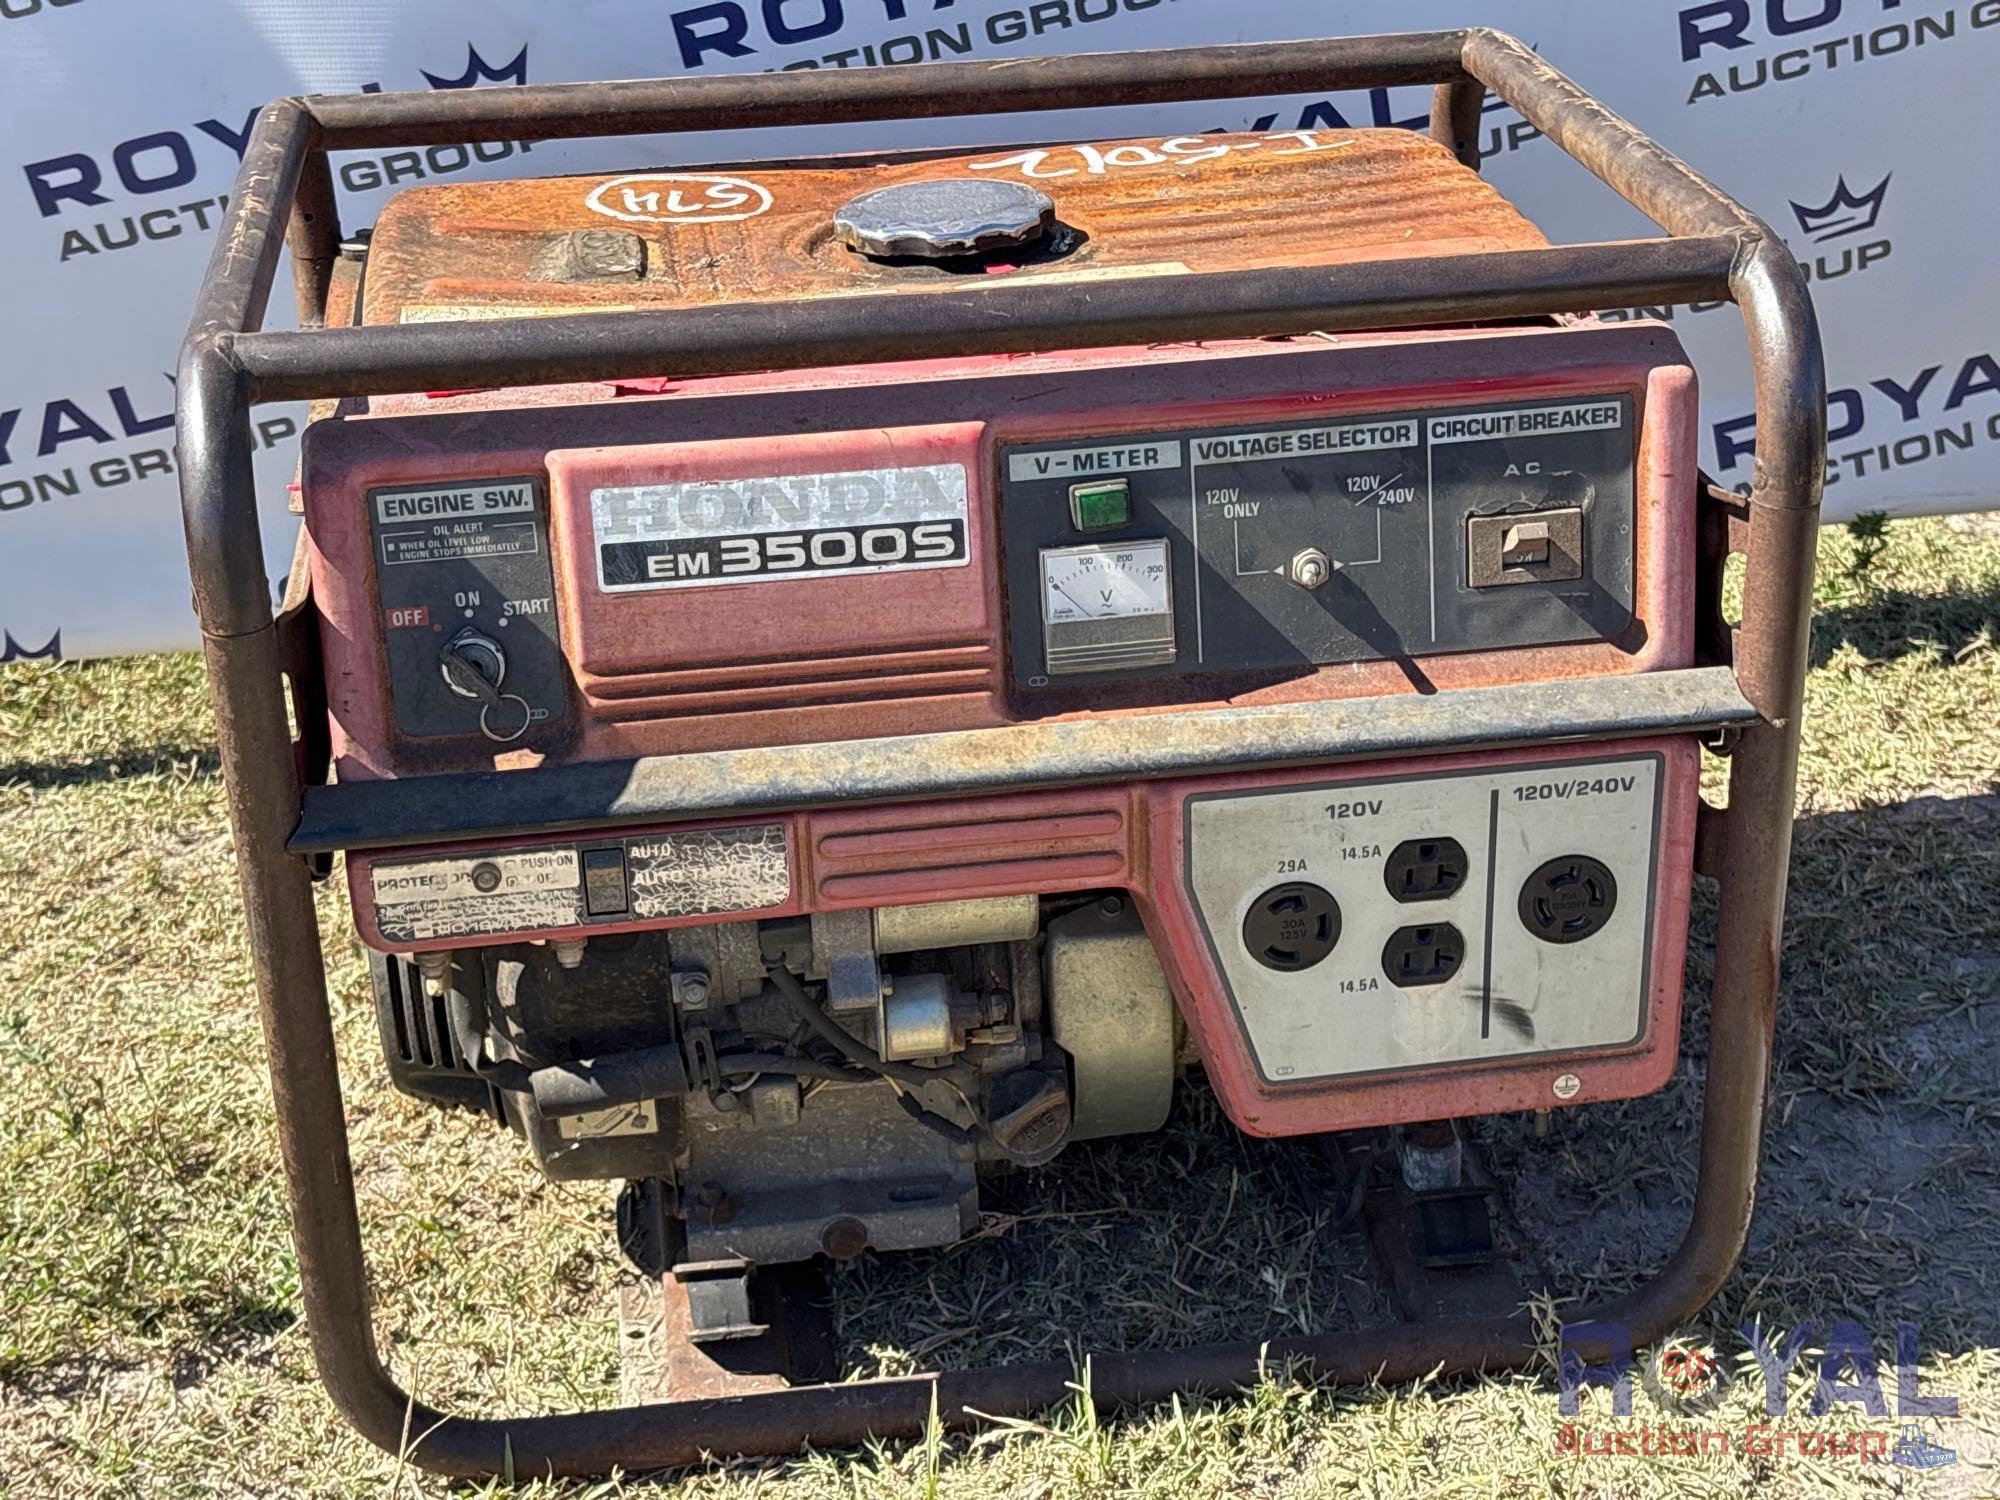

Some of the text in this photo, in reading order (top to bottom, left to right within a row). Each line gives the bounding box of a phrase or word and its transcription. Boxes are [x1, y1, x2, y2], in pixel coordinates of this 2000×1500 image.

[1686, 9, 1956, 105] AUCTION
[1431, 406, 1618, 439] CIRCUIT BREAKER
[1198, 424, 1412, 460] VOLTAGE SELECTOR
[383, 489, 530, 518] ENGINE SW.
[601, 469, 963, 536] HONDA
[1205, 487, 1240, 505] 120V
[1223, 501, 1261, 519] ONLY
[433, 522, 484, 536] OIL ALERT
[399, 535, 490, 551] WHEN OIL LEVEL LOW
[399, 542, 521, 561] ENGINE STOPS IMMEDIATELY
[646, 523, 956, 579] EM 3500S
[1078, 557, 1094, 566] 100
[1116, 553, 1133, 563] 200
[1146, 565, 1164, 574] 300
[1048, 576, 1055, 584] 0
[454, 590, 481, 608] ON
[1100, 589, 1113, 603] V
[503, 597, 550, 617] START
[392, 609, 423, 627] OFF
[1512, 776, 1636, 802] 120V/240V
[1324, 799, 1383, 820] 120V
[1340, 845, 1382, 861] 14.5A
[1277, 859, 1308, 874] 29A
[1282, 920, 1306, 929] 30A
[1280, 929, 1308, 941] 125V
[1338, 979, 1379, 994] 14.5A
